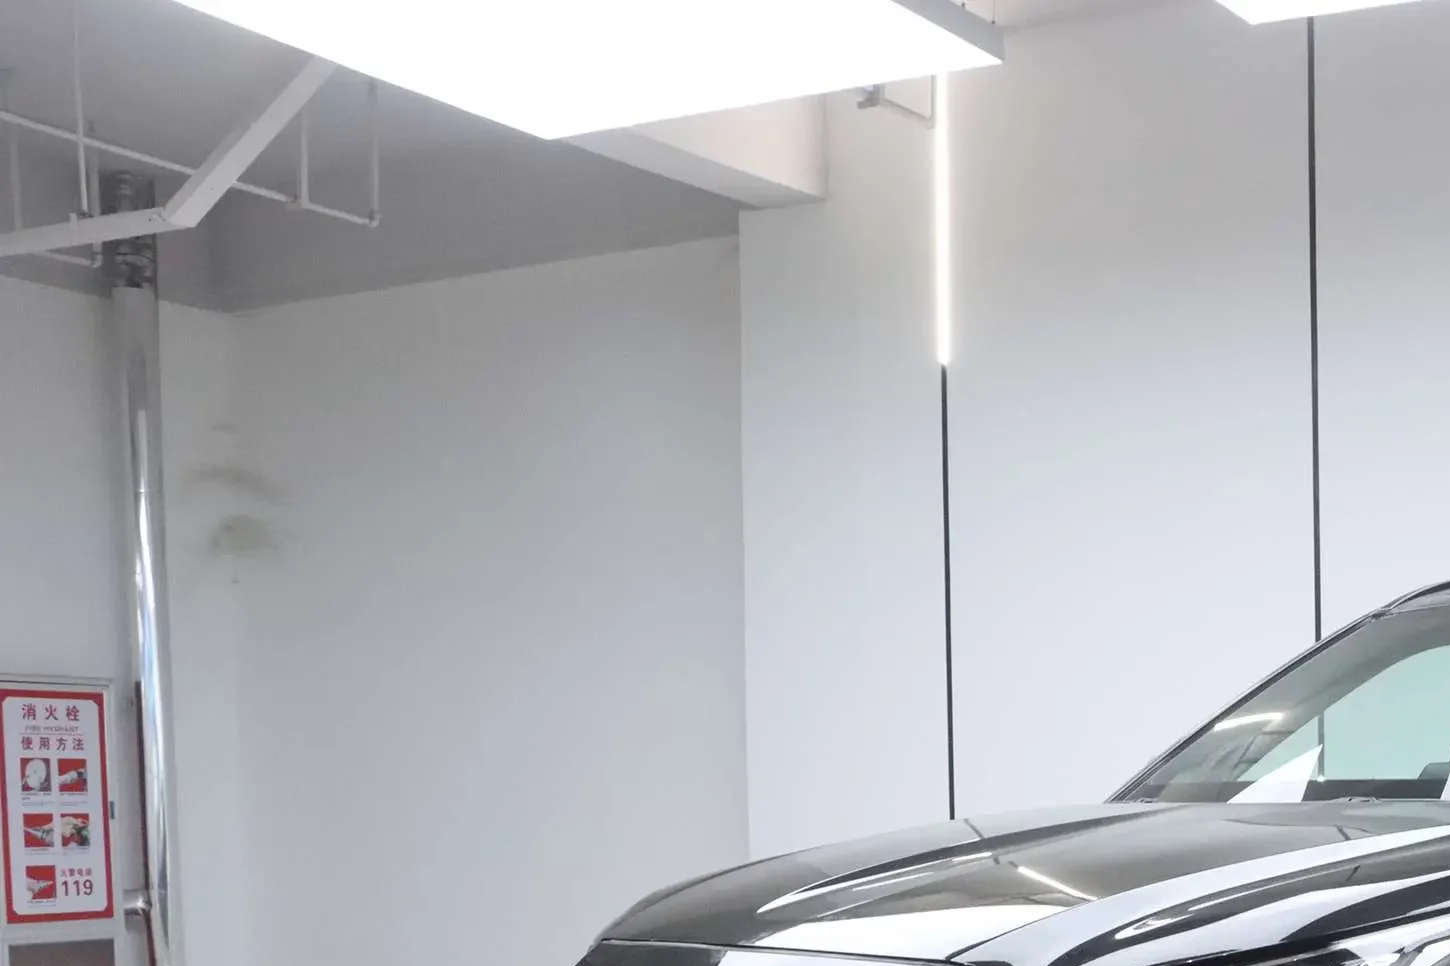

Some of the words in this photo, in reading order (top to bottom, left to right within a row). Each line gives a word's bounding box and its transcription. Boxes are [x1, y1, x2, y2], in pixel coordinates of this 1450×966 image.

[22, 704, 81, 722] 消火栓
[21, 737, 84, 752] 使用方法
[61, 880, 93, 896] 119
